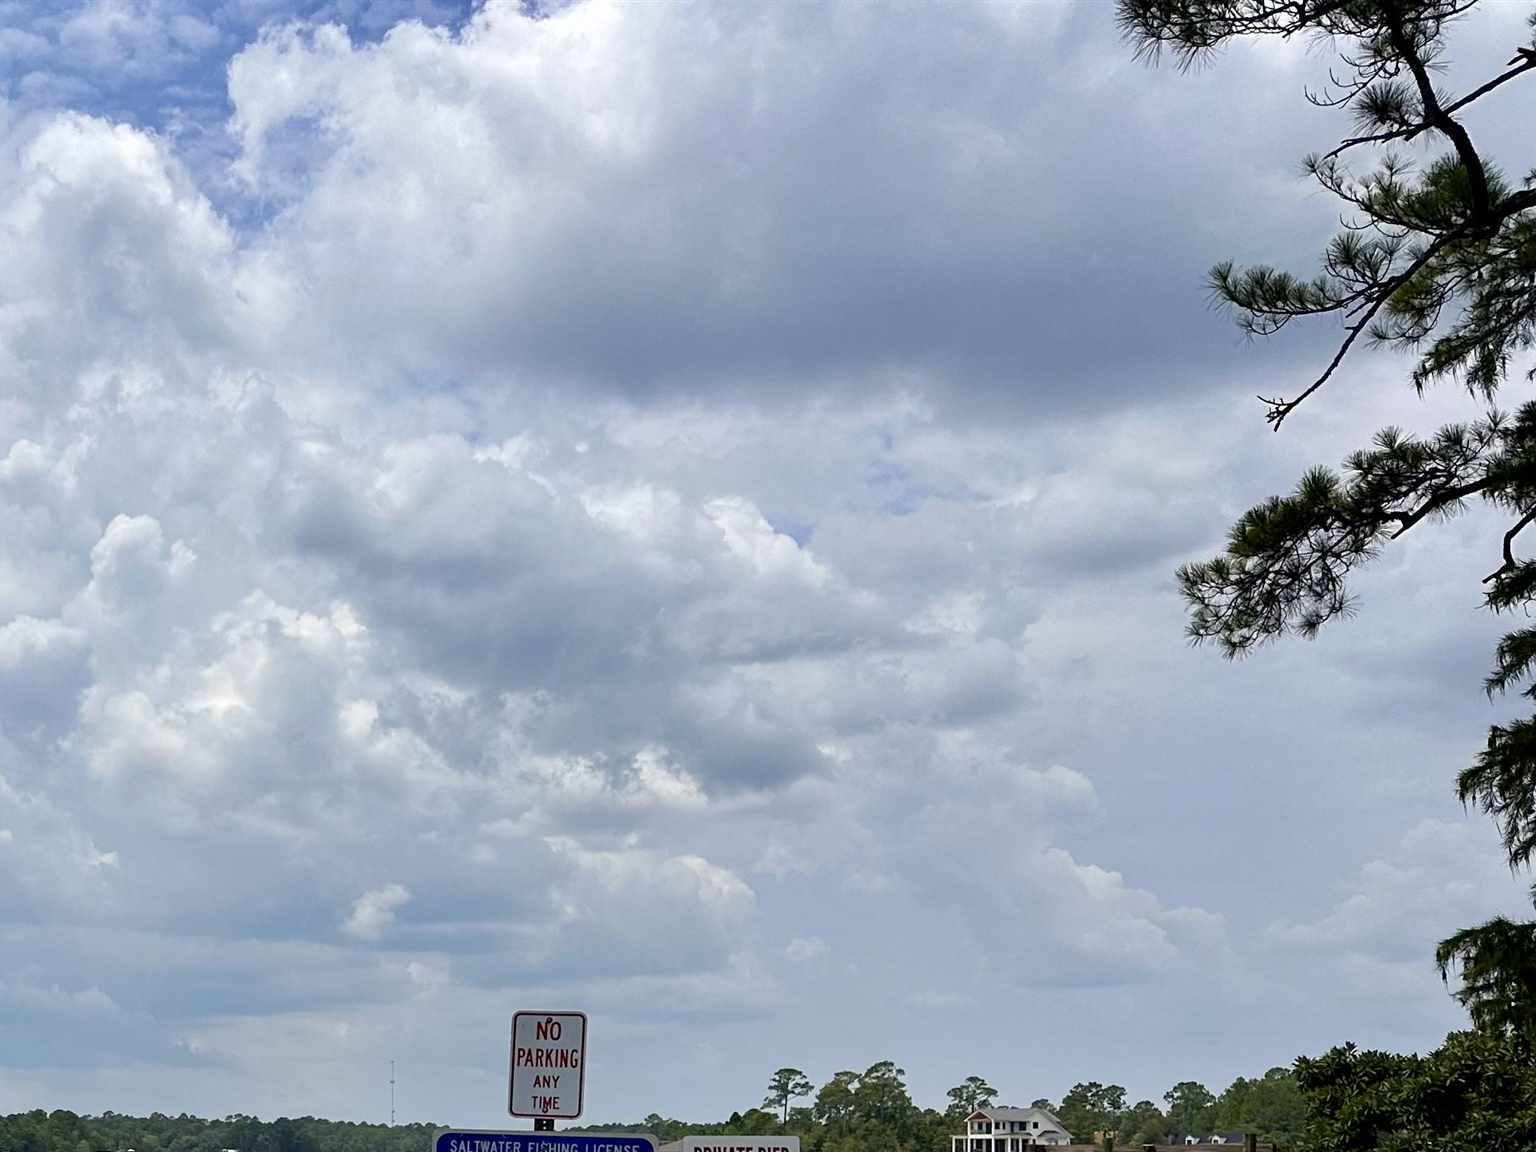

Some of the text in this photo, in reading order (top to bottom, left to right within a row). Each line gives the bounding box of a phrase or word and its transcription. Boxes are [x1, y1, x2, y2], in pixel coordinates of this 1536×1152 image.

[536, 1021, 562, 1041] NO
[516, 1047, 579, 1069] PARKING
[533, 1075, 560, 1089] ANY
[531, 1095, 560, 1110] TIME
